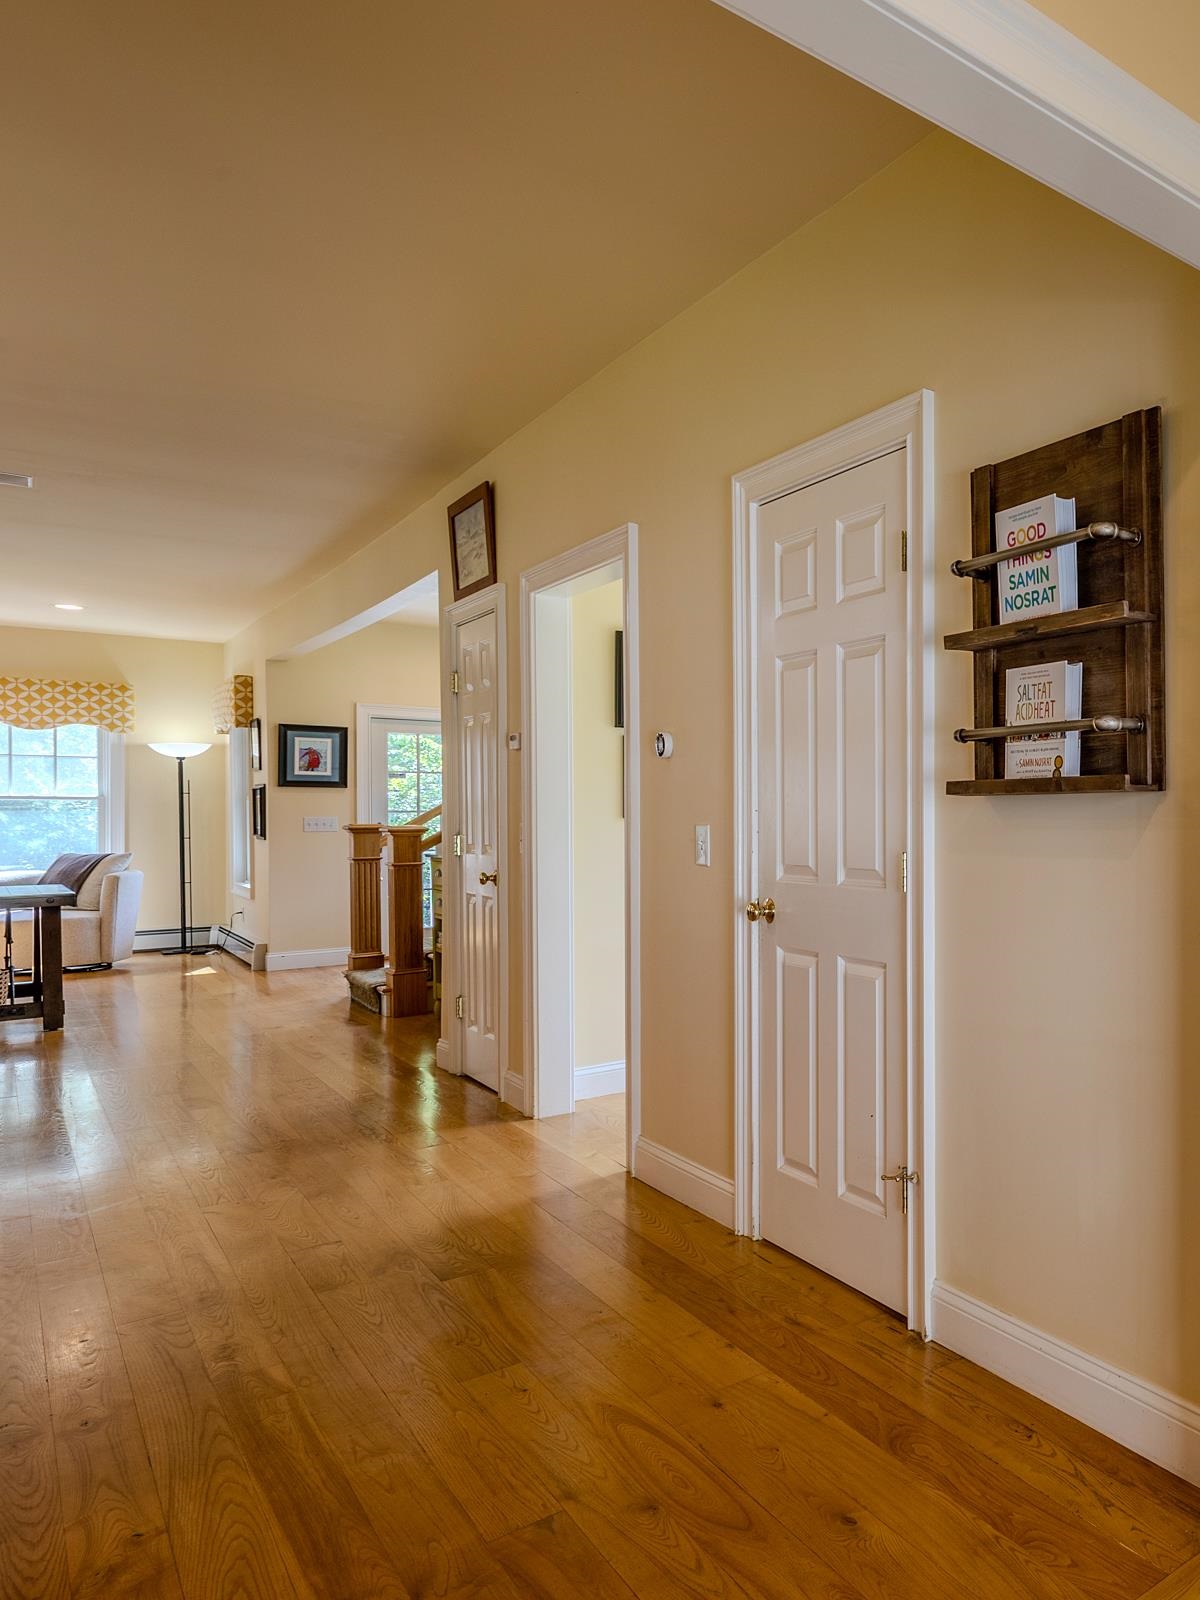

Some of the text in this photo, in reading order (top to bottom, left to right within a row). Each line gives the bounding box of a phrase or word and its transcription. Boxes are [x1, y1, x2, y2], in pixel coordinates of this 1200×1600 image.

[1007, 522, 1046, 547] GOOD
[1009, 565, 1049, 590] SAMIN
[1004, 585, 1056, 612] NOSRAT
